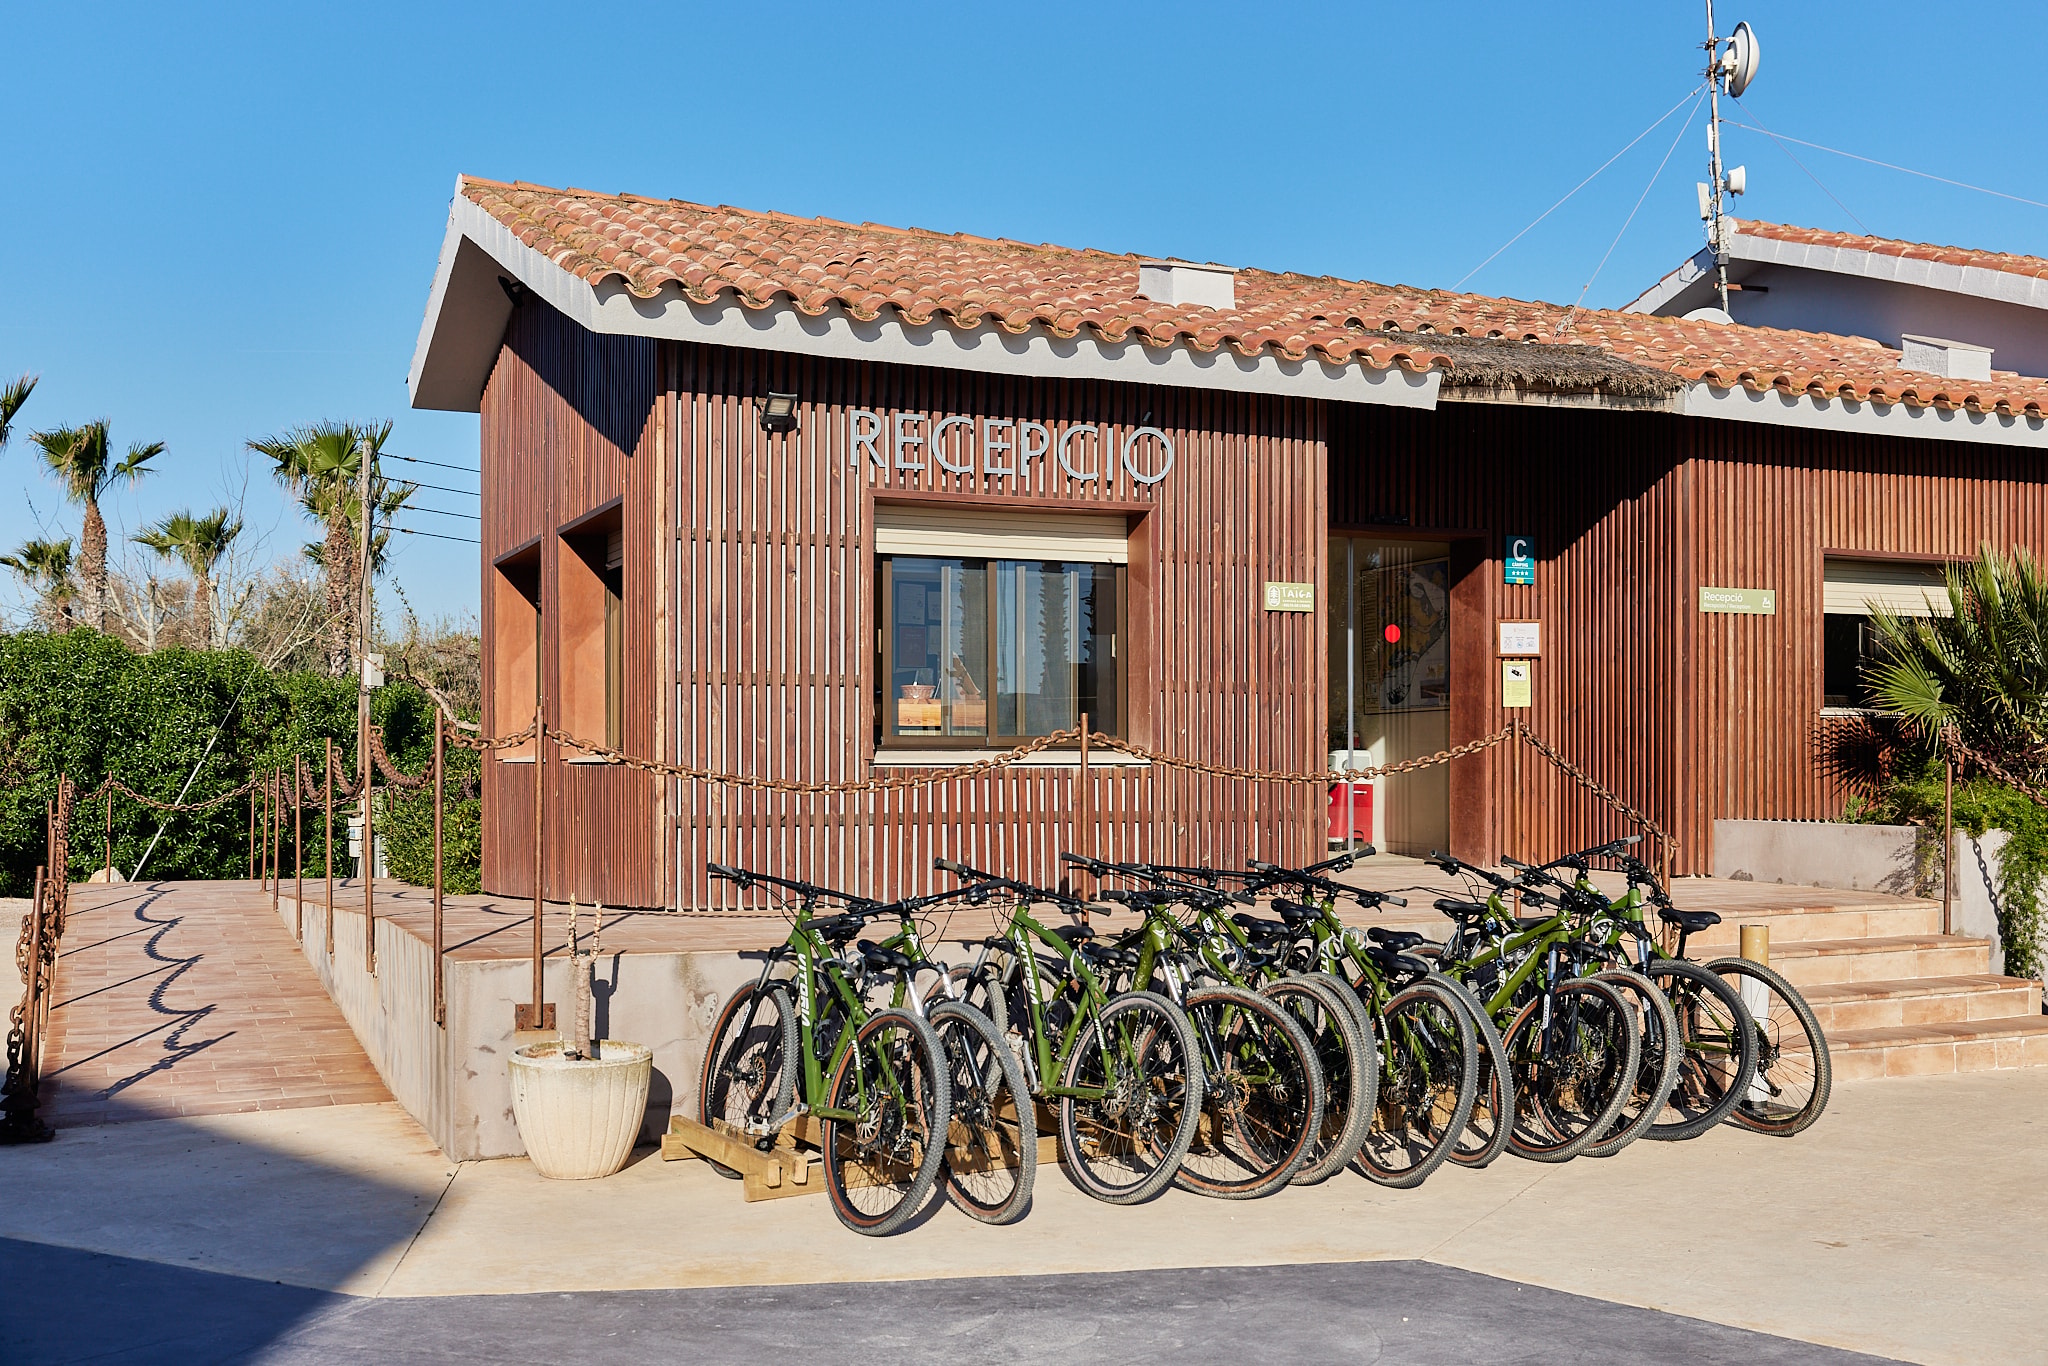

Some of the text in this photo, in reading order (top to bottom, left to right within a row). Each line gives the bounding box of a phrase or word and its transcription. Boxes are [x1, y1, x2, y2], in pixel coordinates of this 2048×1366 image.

[850, 409, 1173, 484] RECEPCIÓ
[1512, 538, 1527, 562] C
[1704, 591, 1743, 604] Recepció
[797, 953, 811, 1027] VITORIA
